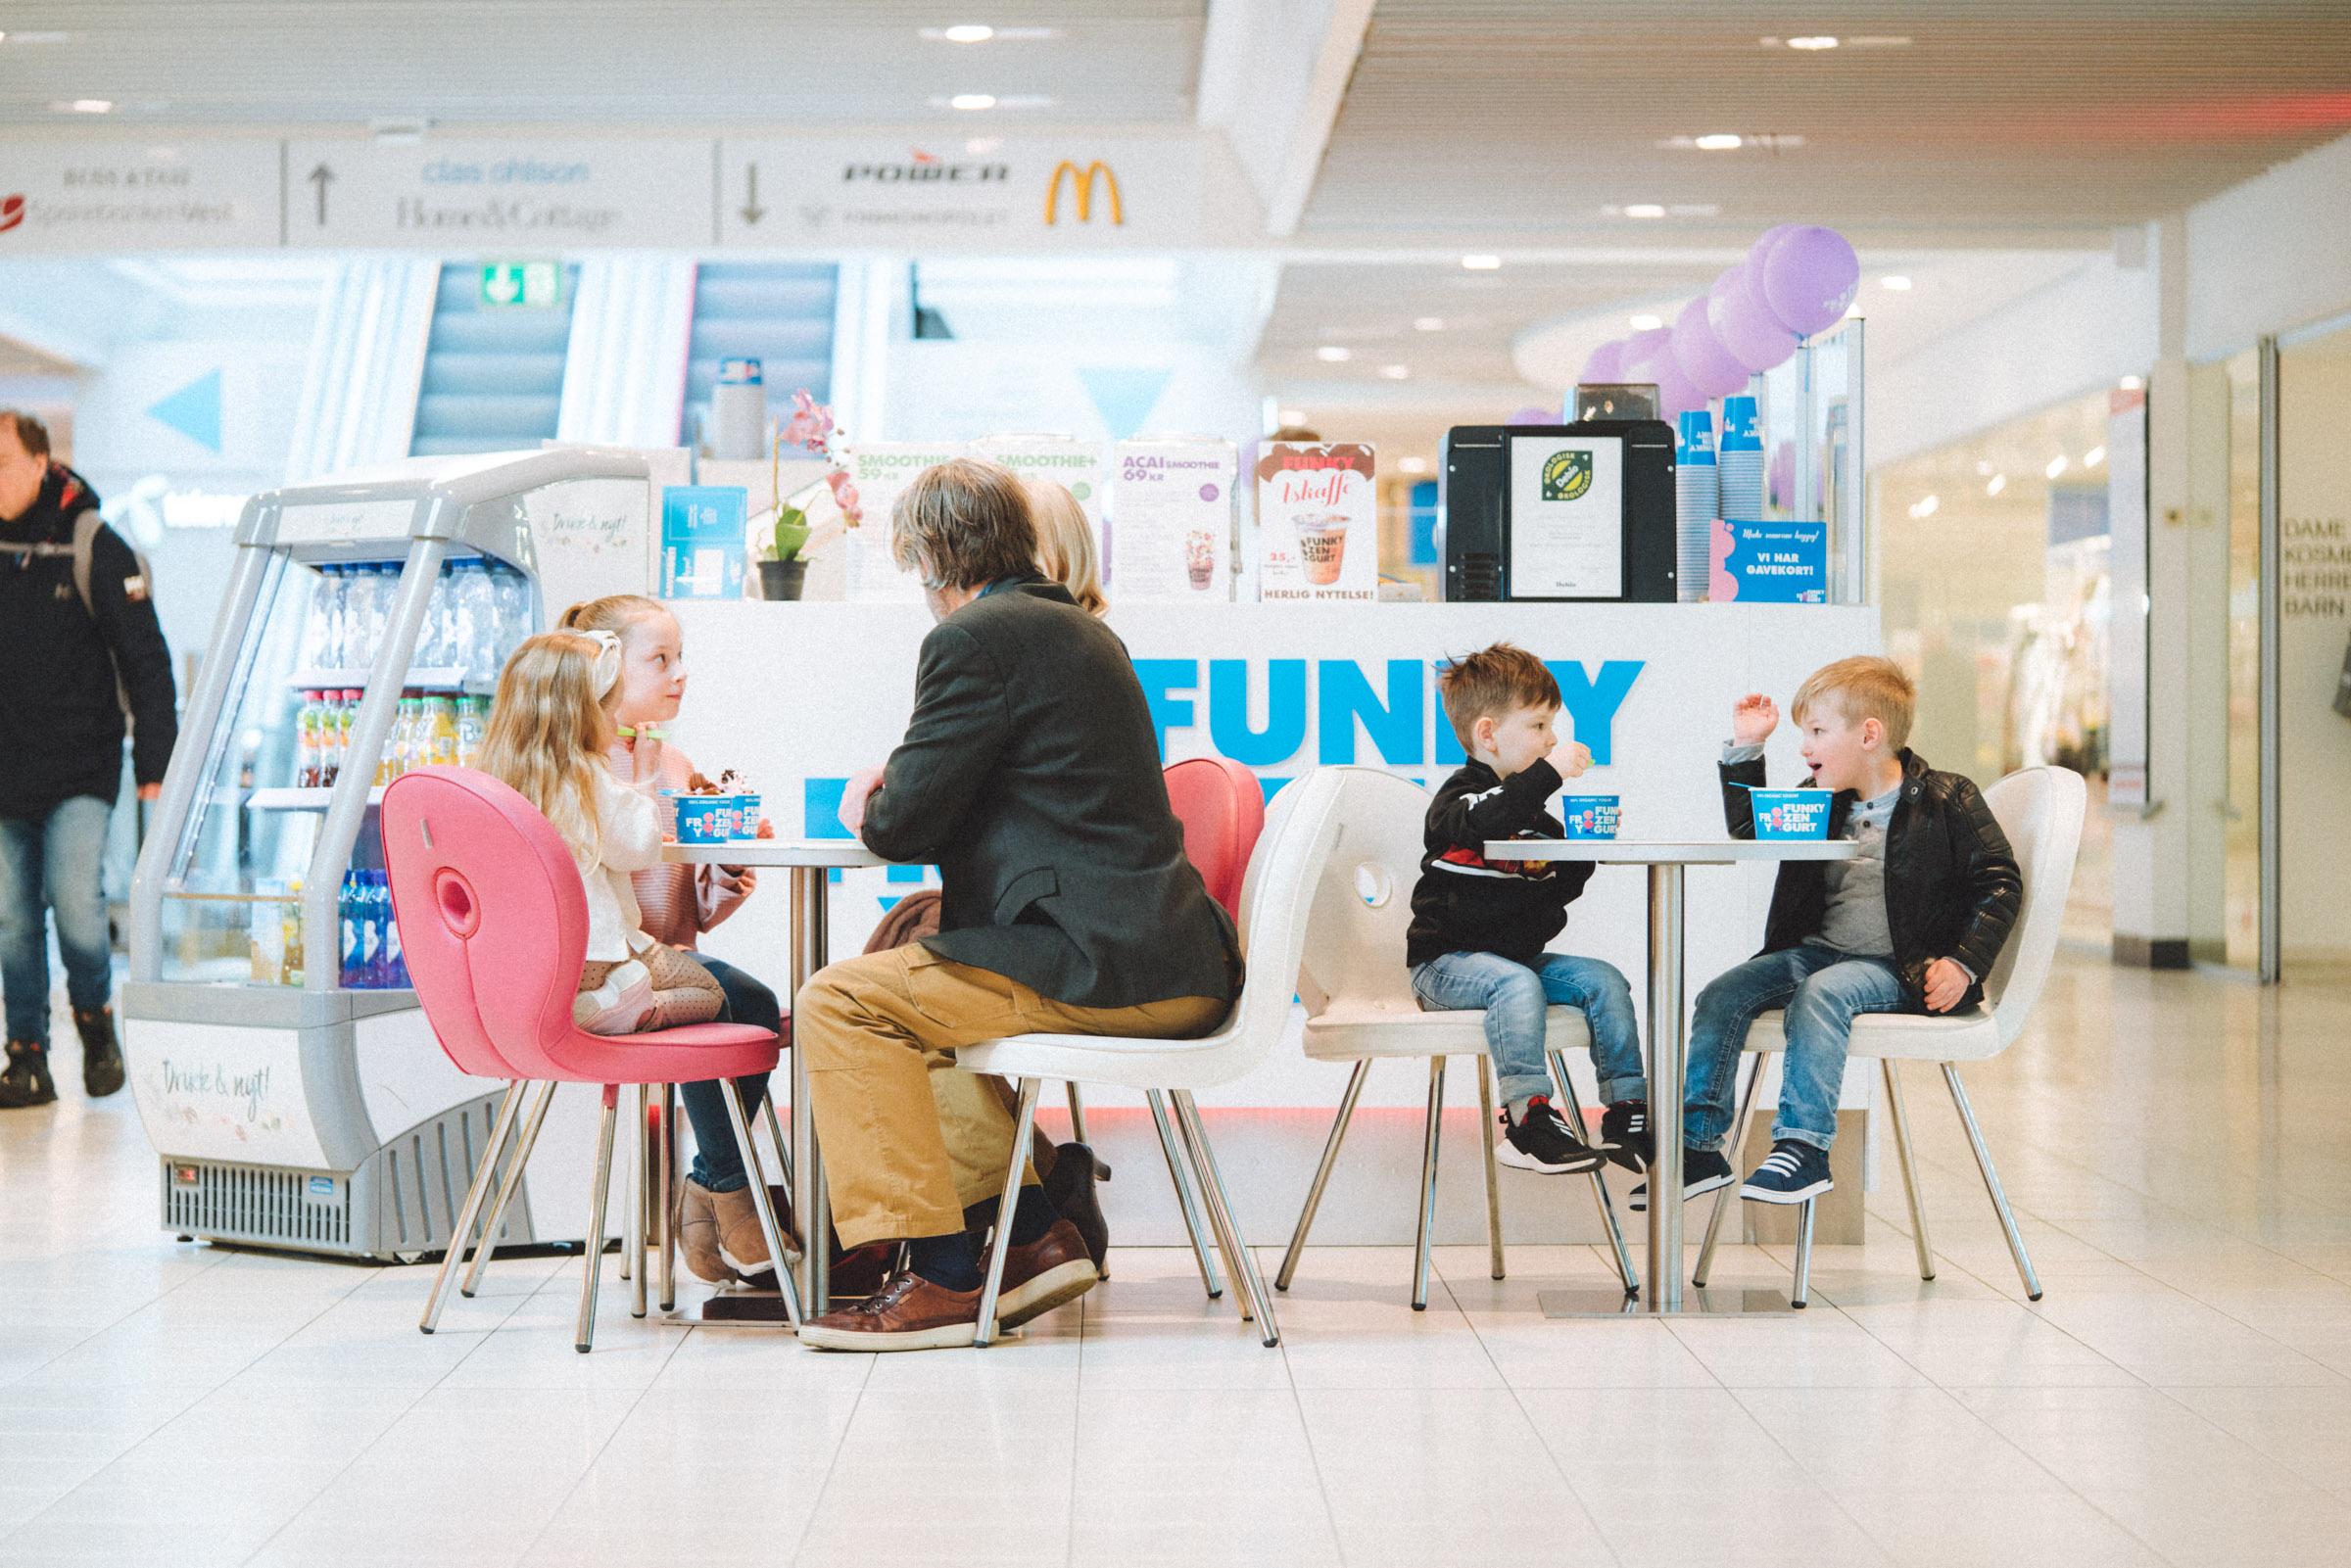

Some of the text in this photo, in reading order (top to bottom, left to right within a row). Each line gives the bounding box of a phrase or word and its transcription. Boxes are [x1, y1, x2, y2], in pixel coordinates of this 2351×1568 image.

[841, 163, 1009, 182] POWER
[1283, 456, 1356, 470] FUNKY
[1123, 469, 1147, 481] 69
[1555, 465, 1580, 489] Debio
[1757, 552, 1799, 563] VI HAR
[1746, 565, 1814, 576] GAVEKORT!
[1265, 590, 1374, 600] HERLIG NYTELSE!
[1783, 803, 1825, 814] FUNKY
